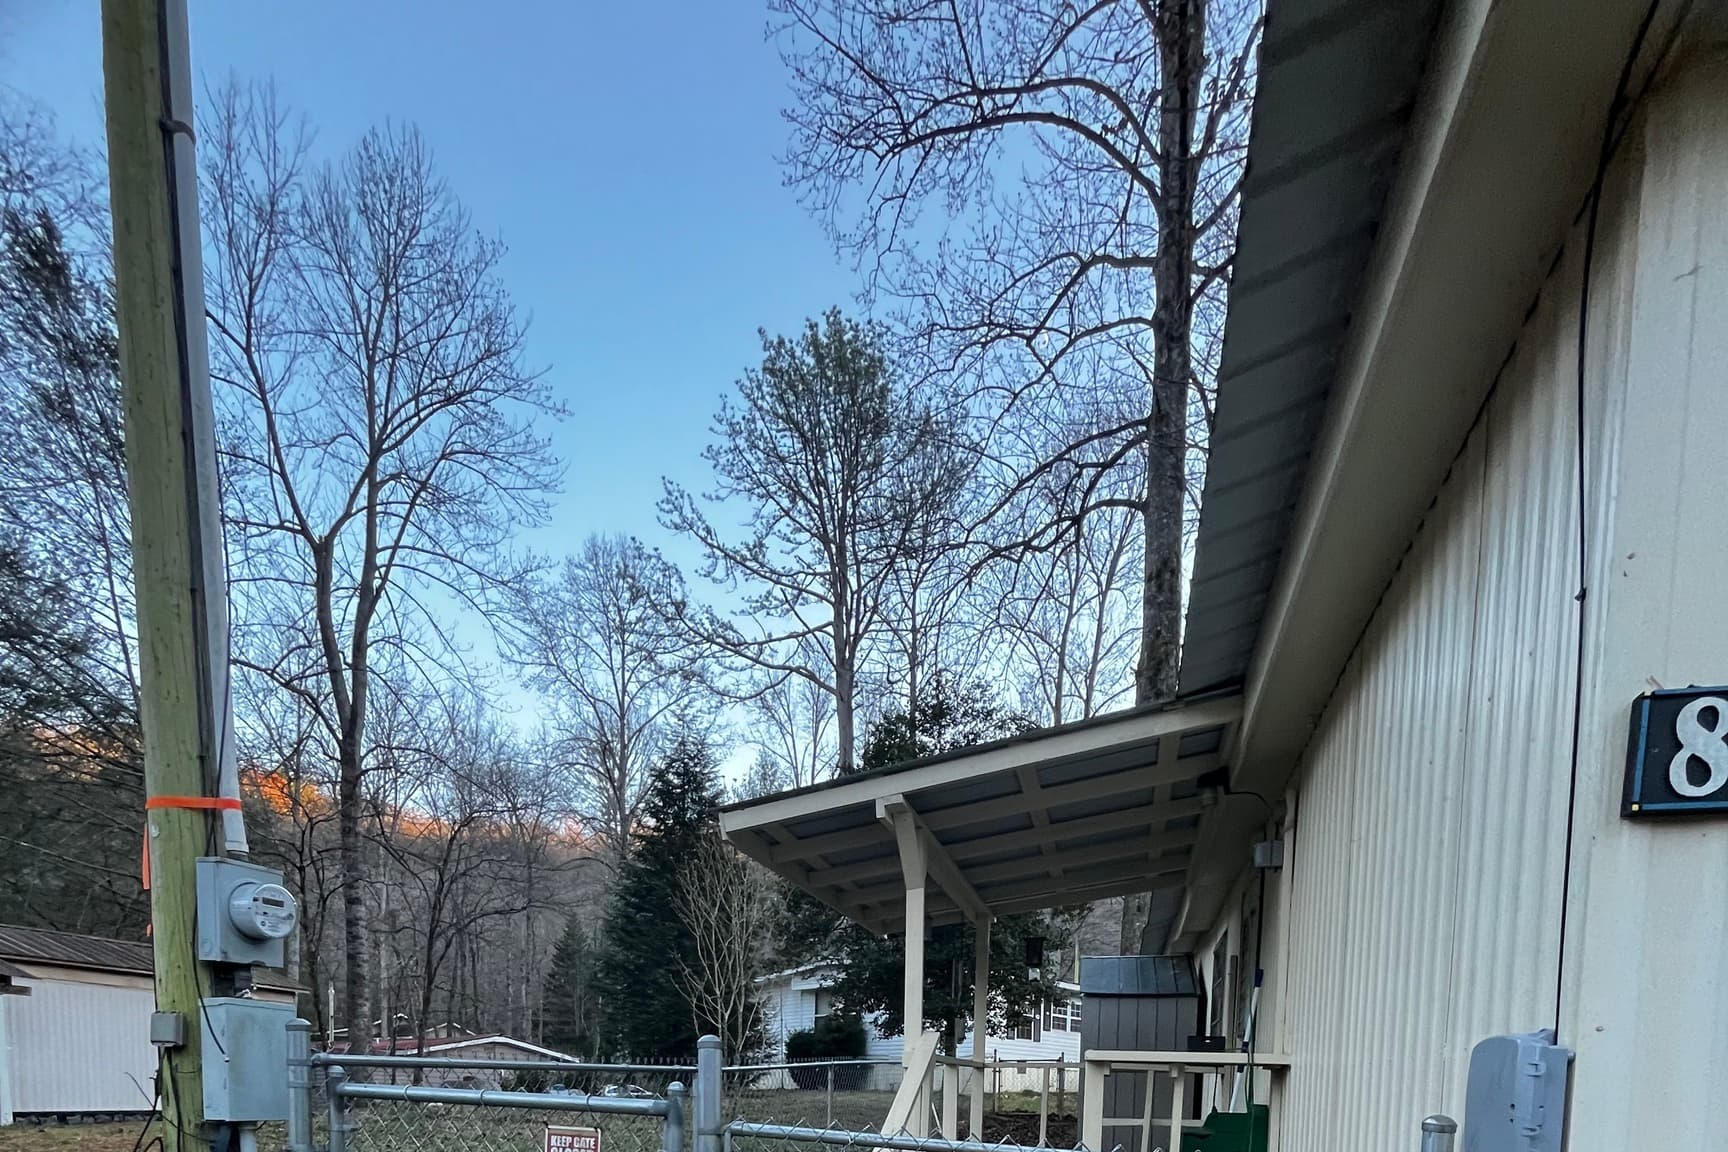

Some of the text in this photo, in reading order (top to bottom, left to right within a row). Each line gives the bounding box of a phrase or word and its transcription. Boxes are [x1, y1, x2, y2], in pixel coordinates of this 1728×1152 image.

[1668, 696, 1728, 797] 8
[550, 1135, 595, 1149] KEEP GATE
